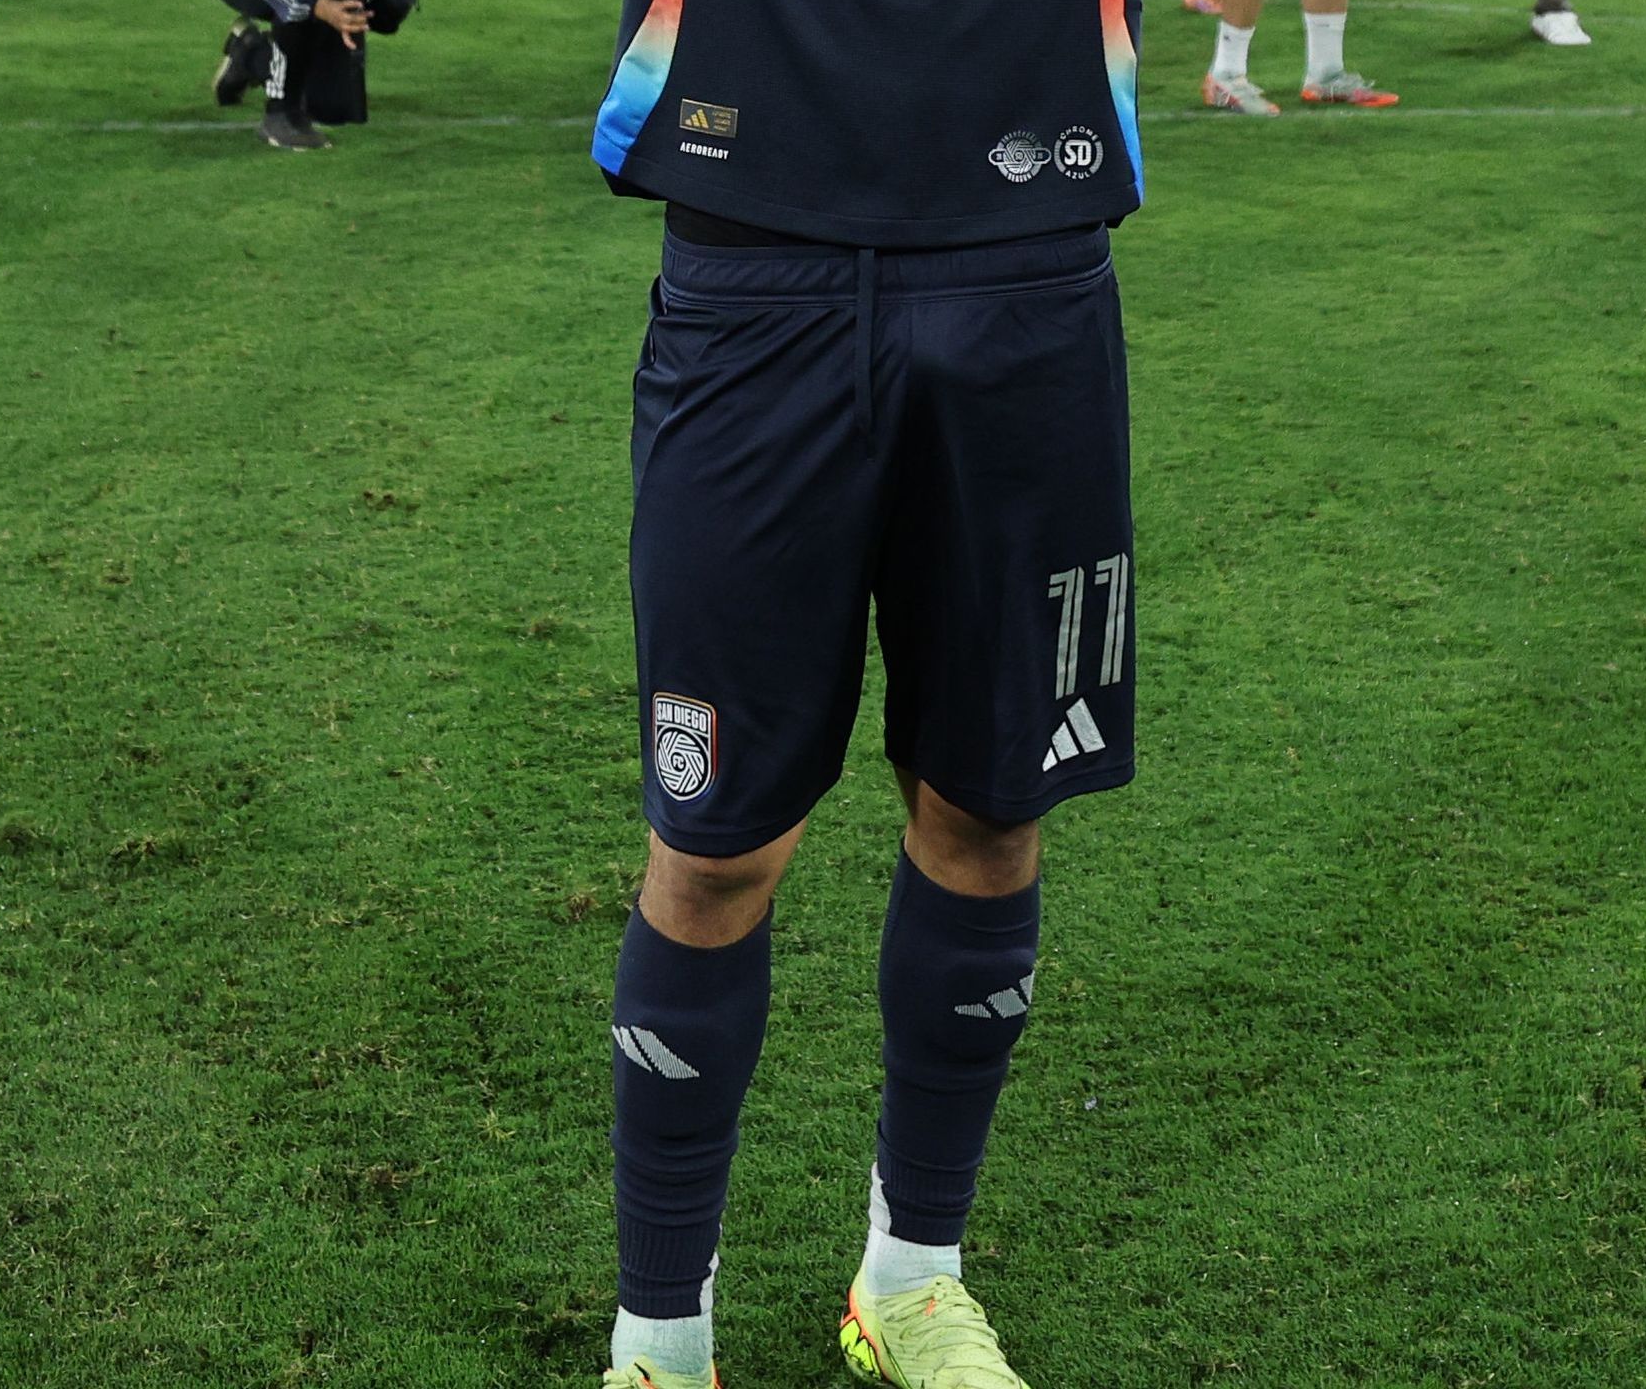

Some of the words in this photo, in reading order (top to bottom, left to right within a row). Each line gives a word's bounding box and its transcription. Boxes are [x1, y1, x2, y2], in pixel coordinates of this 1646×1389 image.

[1060, 125, 1099, 141] CHROME
[680, 141, 729, 160] AEROREADY
[1064, 139, 1092, 166] SD
[1065, 170, 1091, 180] AZUL
[1047, 551, 1129, 701] 11
[657, 701, 673, 722] SAN
[674, 705, 707, 733] DIEGO
[672, 756, 685, 770] FC
